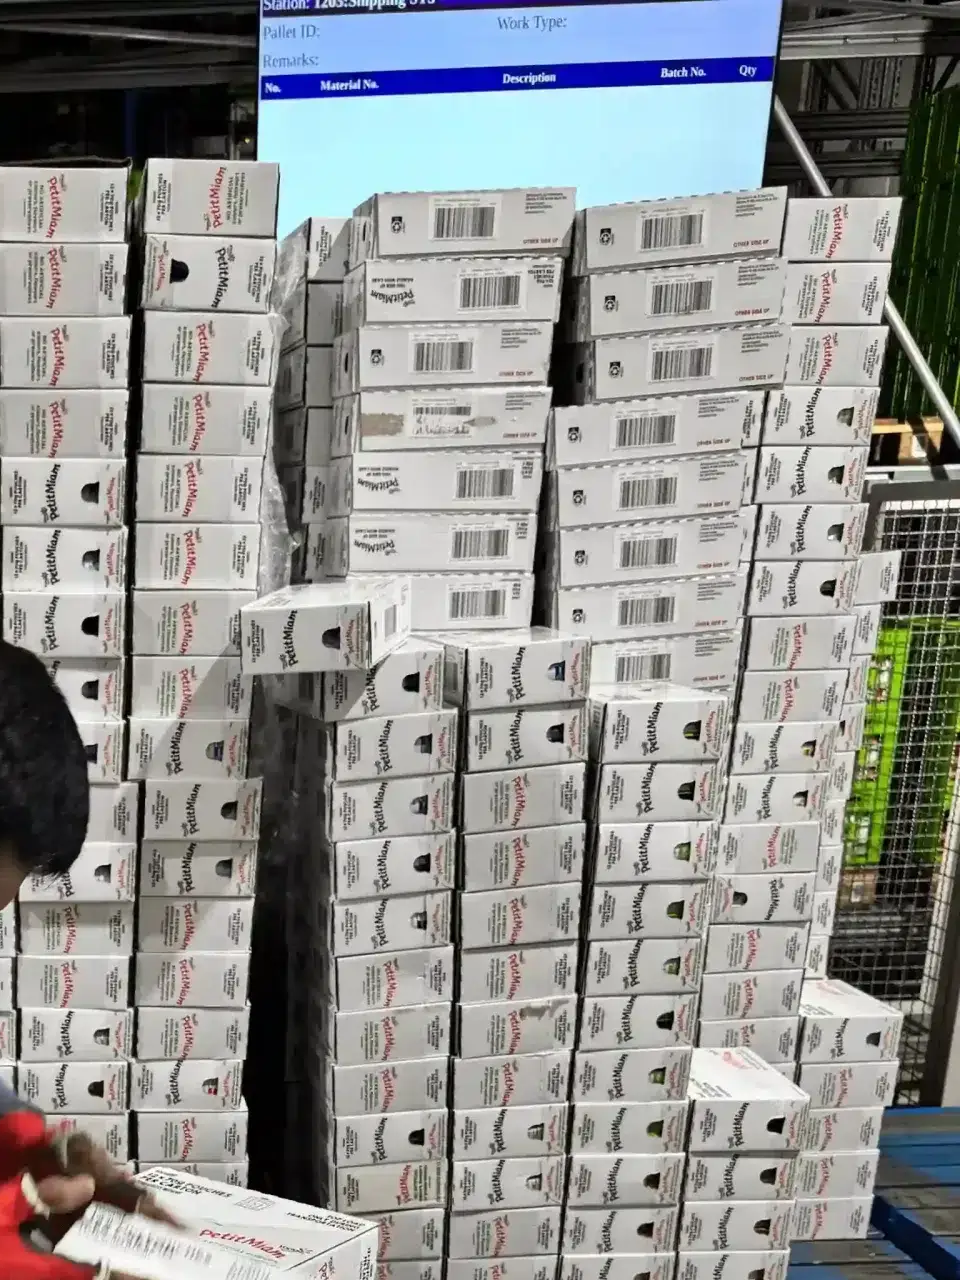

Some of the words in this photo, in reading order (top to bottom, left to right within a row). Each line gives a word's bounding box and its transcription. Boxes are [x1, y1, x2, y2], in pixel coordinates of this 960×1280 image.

[263, 0, 309, 11] Station:
[498, 16, 529, 29] Work
[534, 15, 567, 32] Type:
[263, 25, 296, 40] Pallet
[301, 24, 320, 38] ID:
[263, 54, 319, 69] Remarks:
[660, 67, 688, 78] Batch
[690, 67, 706, 76] No.
[739, 65, 757, 77] Qty
[502, 73, 556, 84] Description
[265, 83, 281, 93] No.
[320, 79, 360, 91] Material
[363, 79, 379, 89] No.
